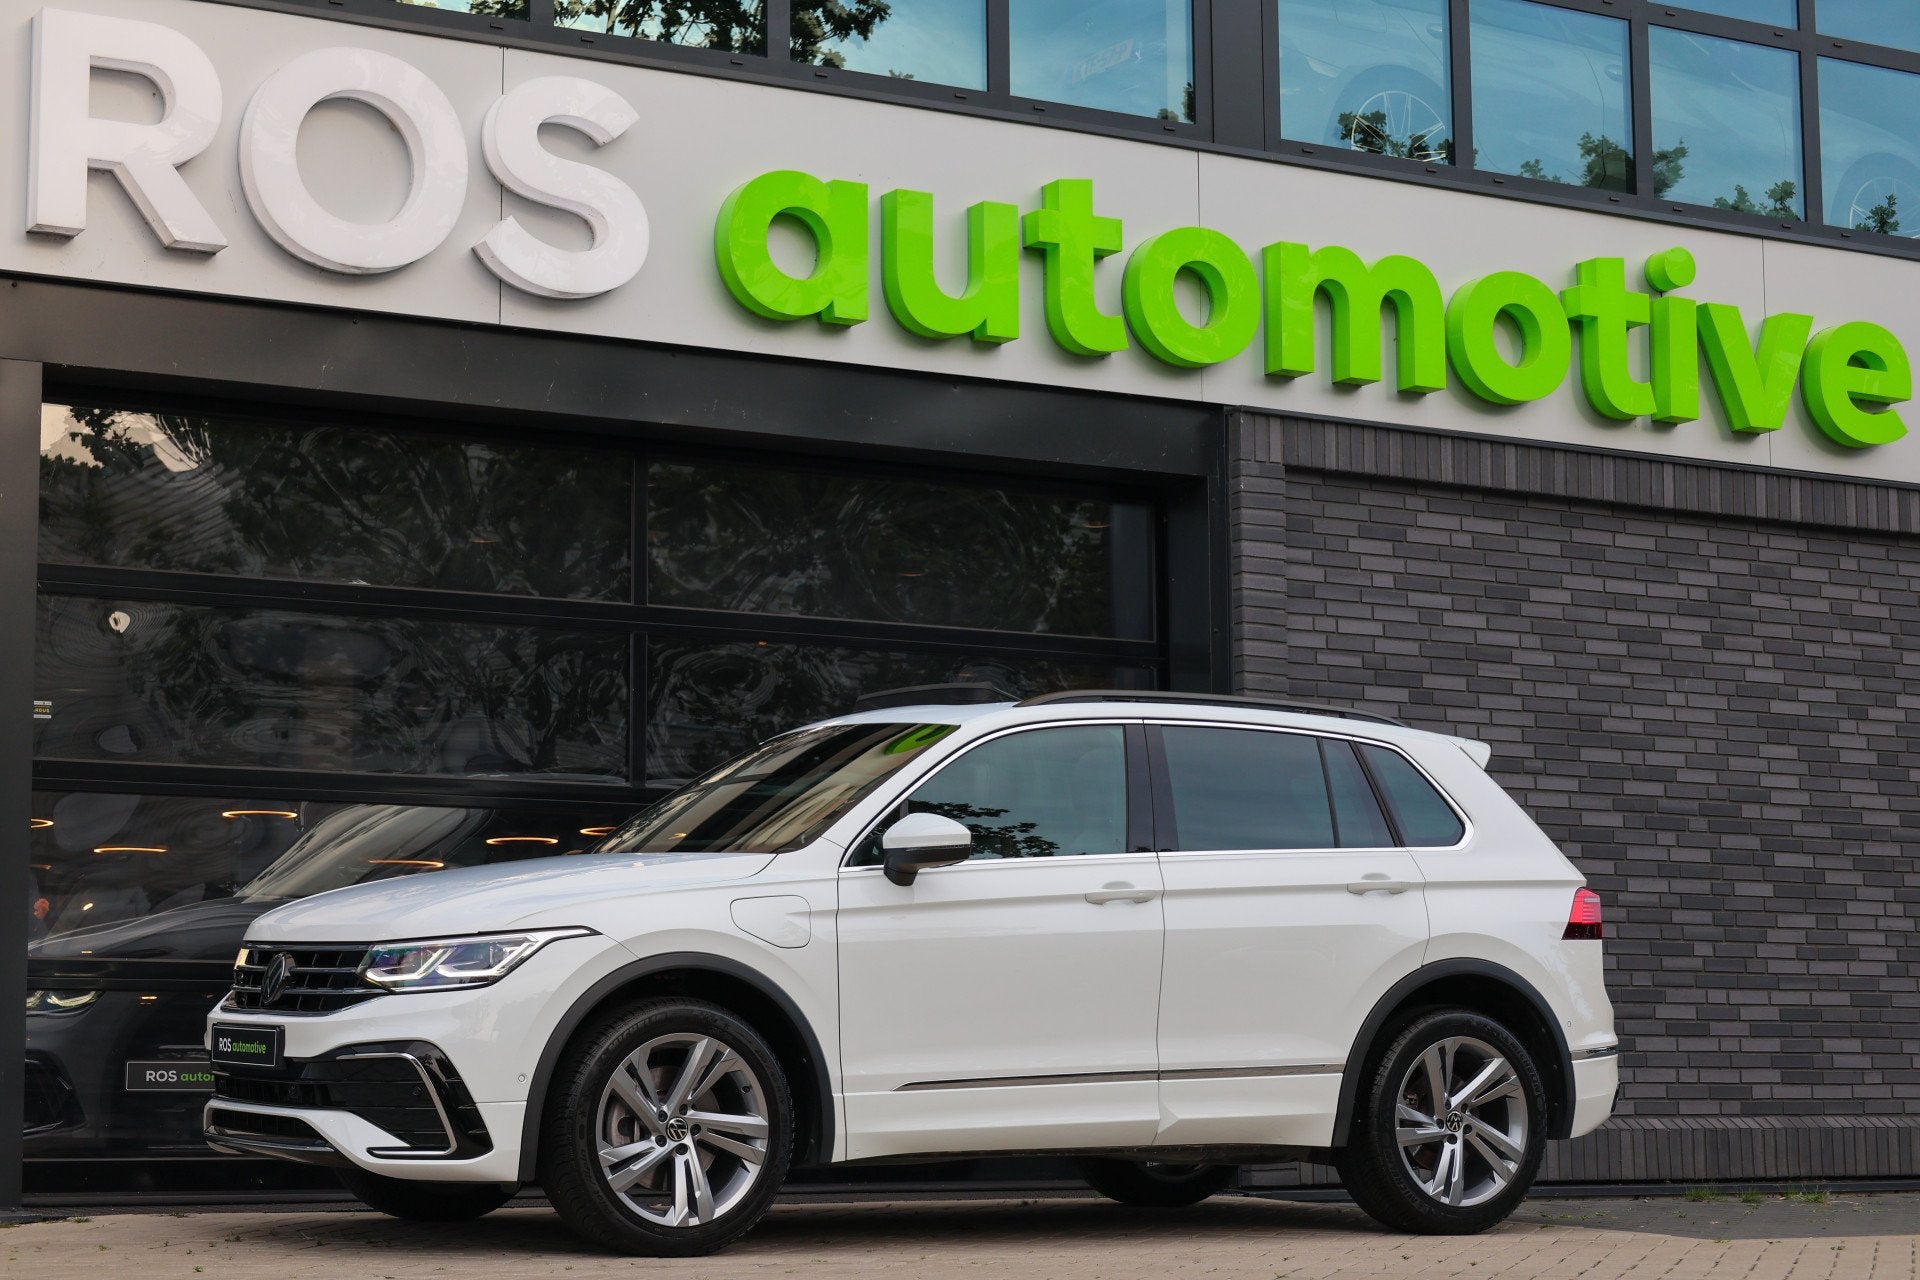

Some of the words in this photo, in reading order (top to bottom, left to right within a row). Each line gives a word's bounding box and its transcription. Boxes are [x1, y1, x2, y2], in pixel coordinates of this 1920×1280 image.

[26, 7, 650, 300] ROS
[714, 169, 1912, 448] automotive
[218, 1037, 232, 1053] ROS
[232, 1040, 267, 1054] automotive
[145, 1070, 178, 1082] ROS
[180, 1071, 215, 1082] auto
